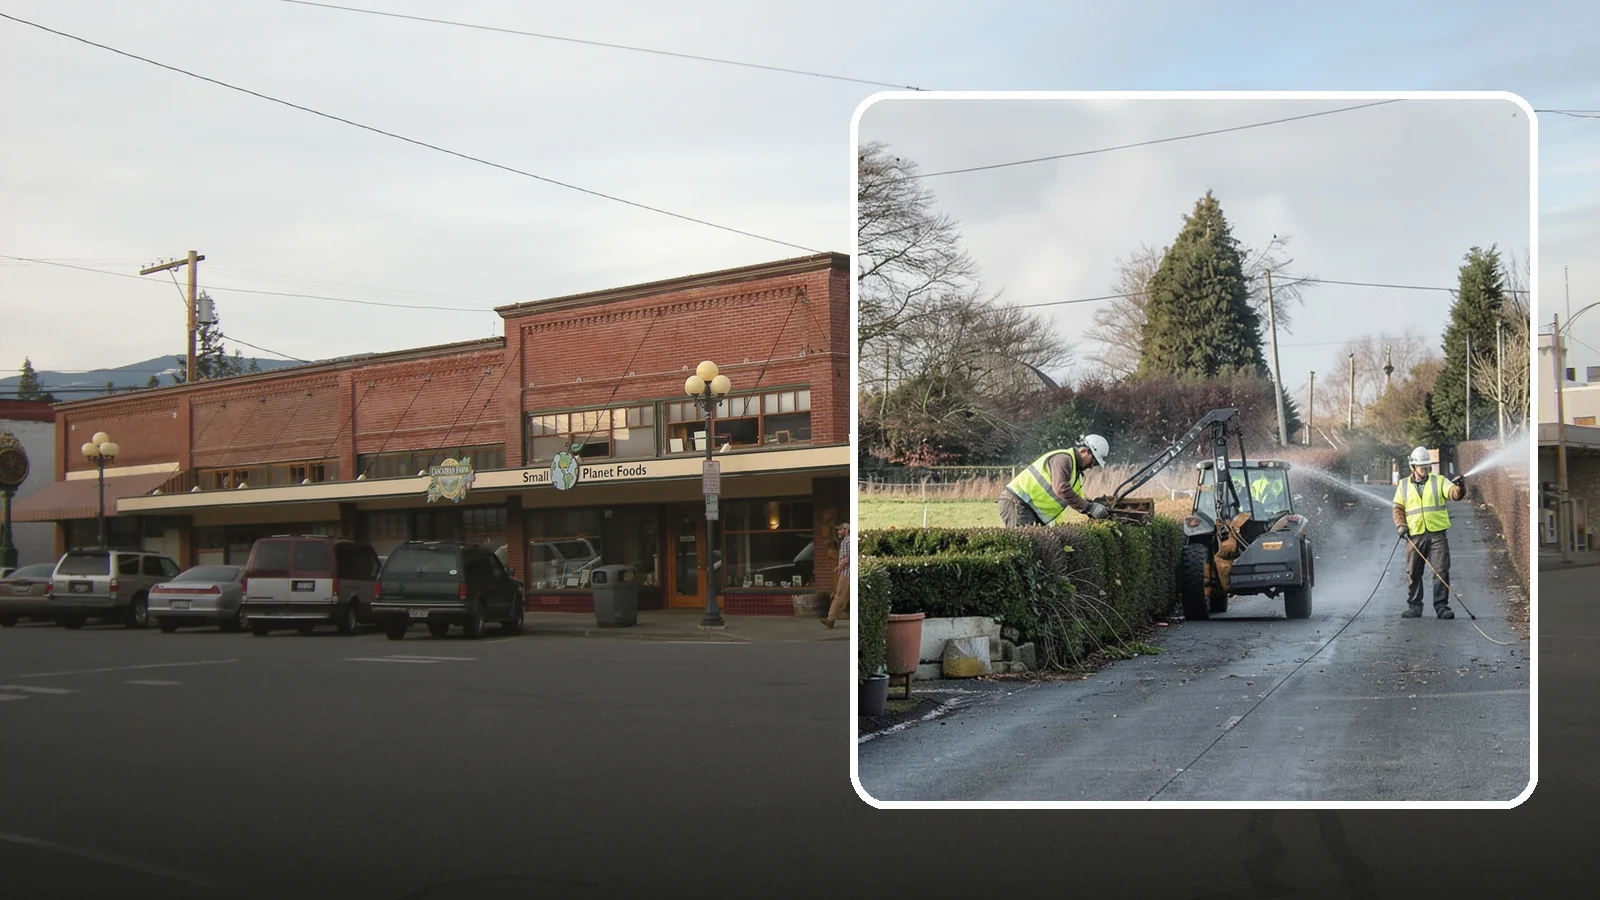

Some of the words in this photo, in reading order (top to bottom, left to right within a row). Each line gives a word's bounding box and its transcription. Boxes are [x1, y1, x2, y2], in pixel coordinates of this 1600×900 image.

[523, 471, 548, 482] Small
[583, 467, 614, 479] Planet
[617, 464, 647, 476] Foods
